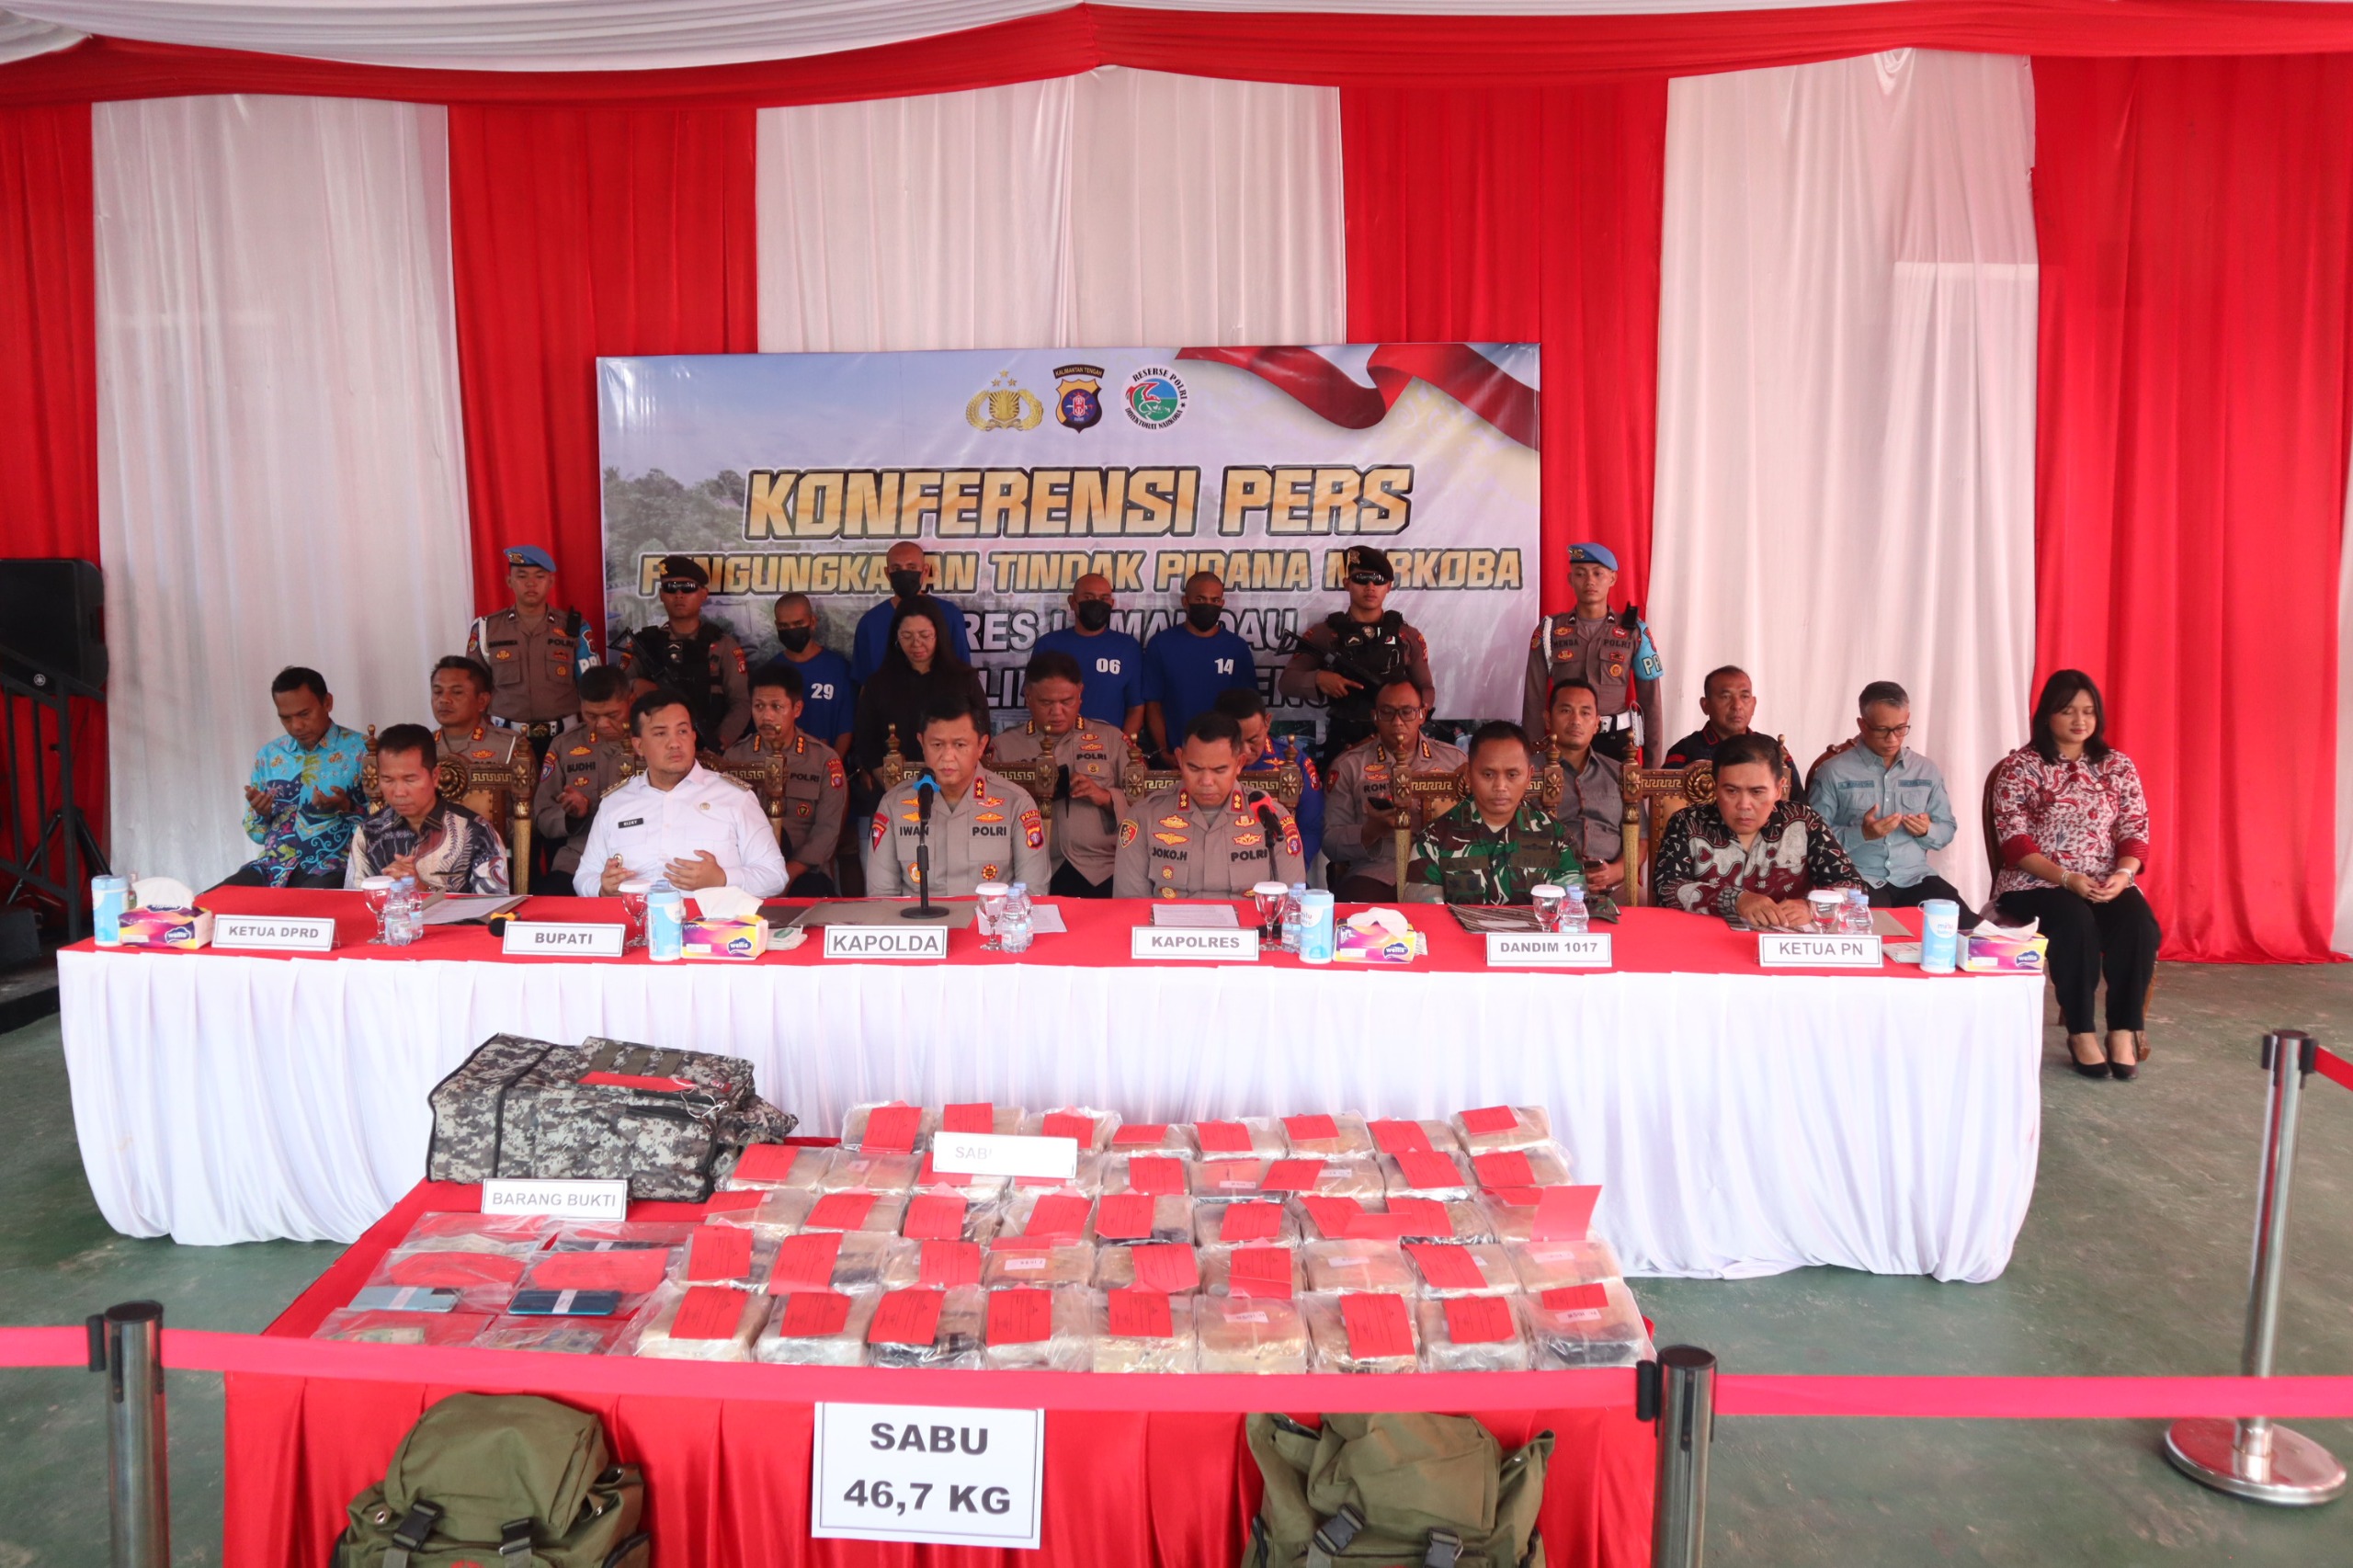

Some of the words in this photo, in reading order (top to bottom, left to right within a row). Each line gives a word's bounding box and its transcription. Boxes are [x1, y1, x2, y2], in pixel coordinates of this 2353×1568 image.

[1055, 367, 1084, 377] KALIMANTAN
[1085, 367, 1103, 377] TENGAH
[1132, 368, 1168, 382] RESERSE
[1169, 373, 1188, 400] POLRI
[1125, 407, 1157, 430] DIREKTORAT
[1158, 410, 1183, 430] NARKOBA
[745, 469, 1199, 540] KONFERENSI
[1219, 465, 1414, 536] PERS
[640, 551, 979, 595] PNGUNGKAAN
[990, 551, 1146, 593] TINDAK
[1322, 548, 1523, 591] NRKOBA
[548, 639, 574, 648] POLRI
[1603, 638, 1631, 648] POLRI
[1096, 658, 1121, 675] 06
[1214, 658, 1234, 676] 14
[811, 683, 835, 700] 29
[1076, 753, 1107, 761] POLRI
[567, 761, 597, 773] BUDHI
[790, 772, 820, 781] POLRI
[1363, 782, 1391, 793] RON
[899, 825, 929, 836] IWAN
[972, 826, 1007, 836] POLRI
[1152, 846, 1188, 861] JOKO.H
[1231, 849, 1268, 862] POLRI
[229, 926, 276, 937] KETUA
[280, 927, 319, 939] DPRD
[535, 932, 592, 945] BUPATI
[833, 935, 939, 951] KAPOLDA
[1152, 936, 1240, 949] KAPOLRES
[1500, 942, 1559, 953] DANDIM
[1564, 942, 1598, 953] 1017
[1779, 942, 1836, 955] KETUA
[1841, 943, 1863, 956] PN
[493, 1192, 563, 1206] BARANG
[567, 1194, 616, 1207] BUKTI
[870, 1423, 988, 1455] SABU
[844, 1479, 933, 1517] 46,7
[949, 1484, 1010, 1515] KG
